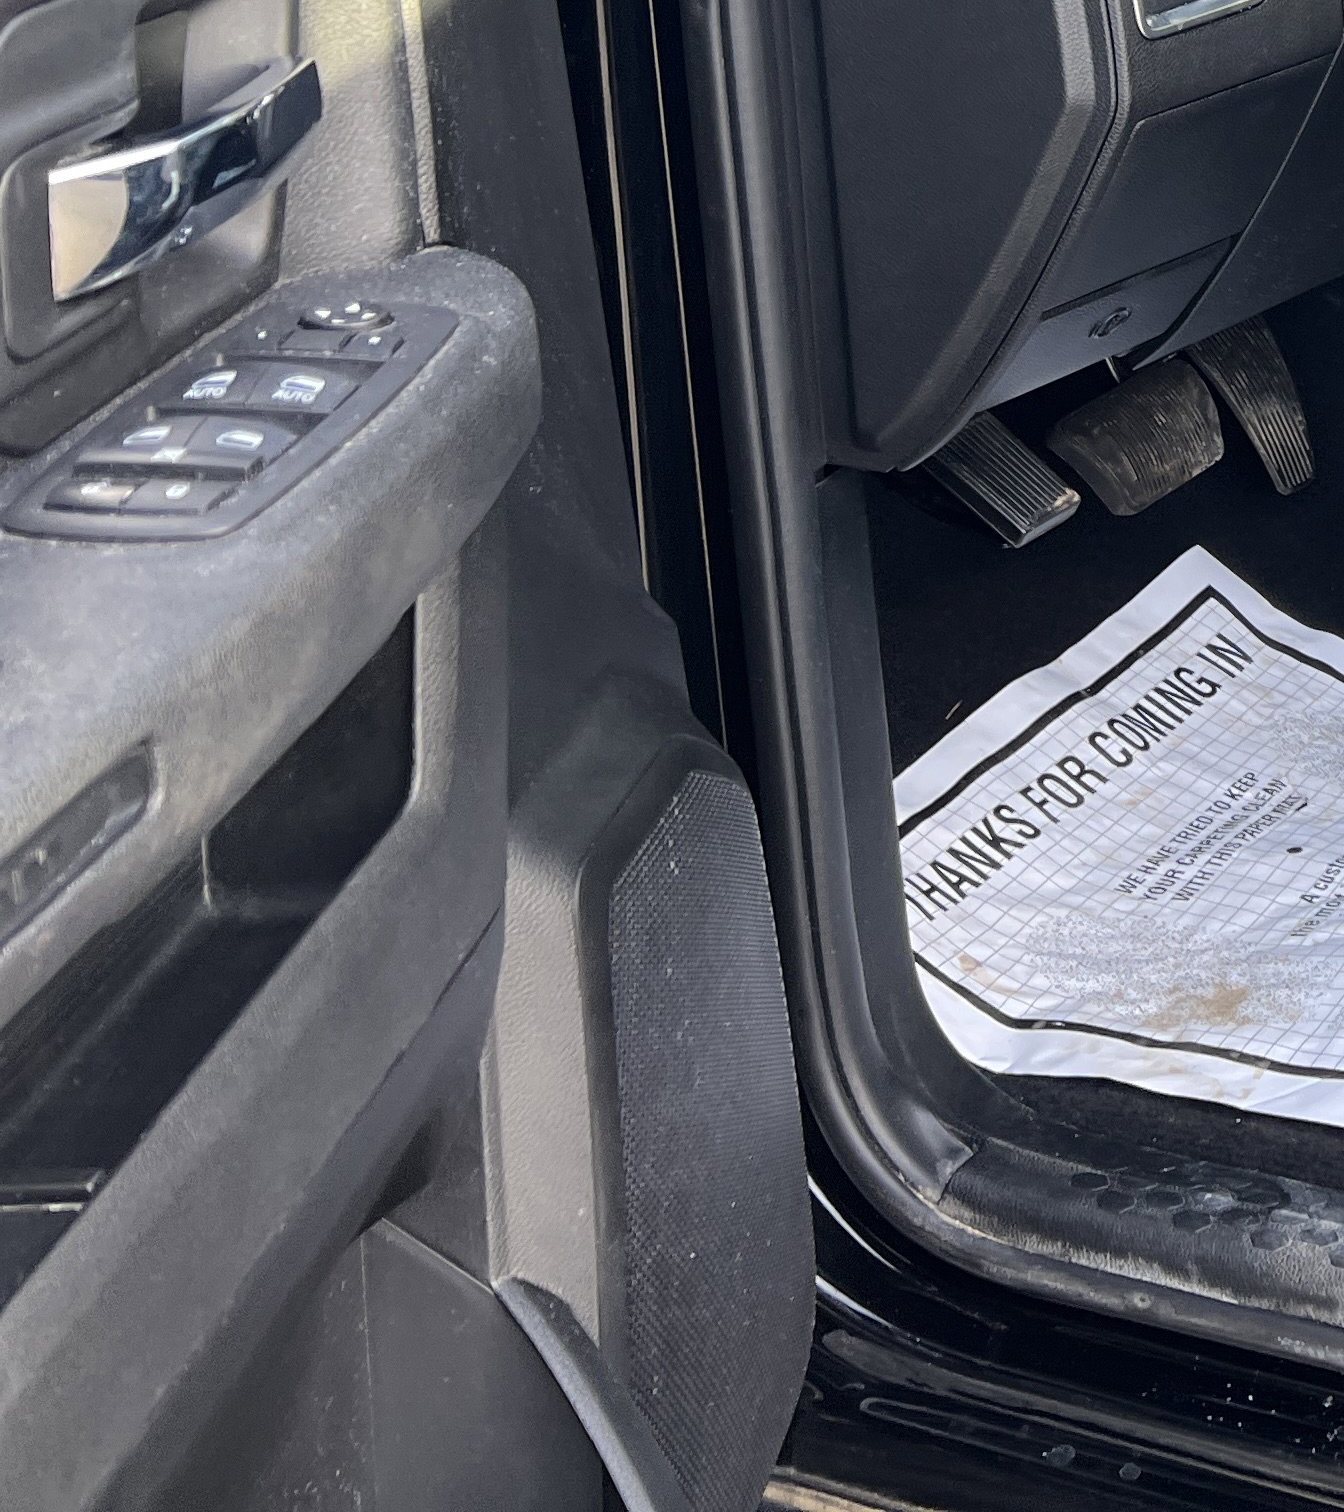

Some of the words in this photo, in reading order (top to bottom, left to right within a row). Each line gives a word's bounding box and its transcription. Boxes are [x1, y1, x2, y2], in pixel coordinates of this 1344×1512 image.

[182, 386, 227, 401] AUTO
[271, 389, 316, 405] AUTO
[1020, 756, 1110, 824] FOR
[1088, 667, 1222, 767] COMING
[1197, 633, 1254, 678] IN
[1116, 873, 1146, 895] WE
[1137, 845, 1178, 876] HAVE
[1175, 815, 1214, 845] TRIED
[1205, 800, 1232, 819] TO
[1224, 772, 1259, 801] KEEP
[1139, 868, 1186, 901] YOUR
[1176, 813, 1248, 866] CARPETING
[1242, 778, 1288, 815] CLEAN
[1171, 869, 1215, 902] WITH
[1205, 841, 1243, 867] THIS
[1234, 814, 1277, 842] PAPER
[1300, 893, 1321, 905] A
[1291, 919, 1320, 937] the
